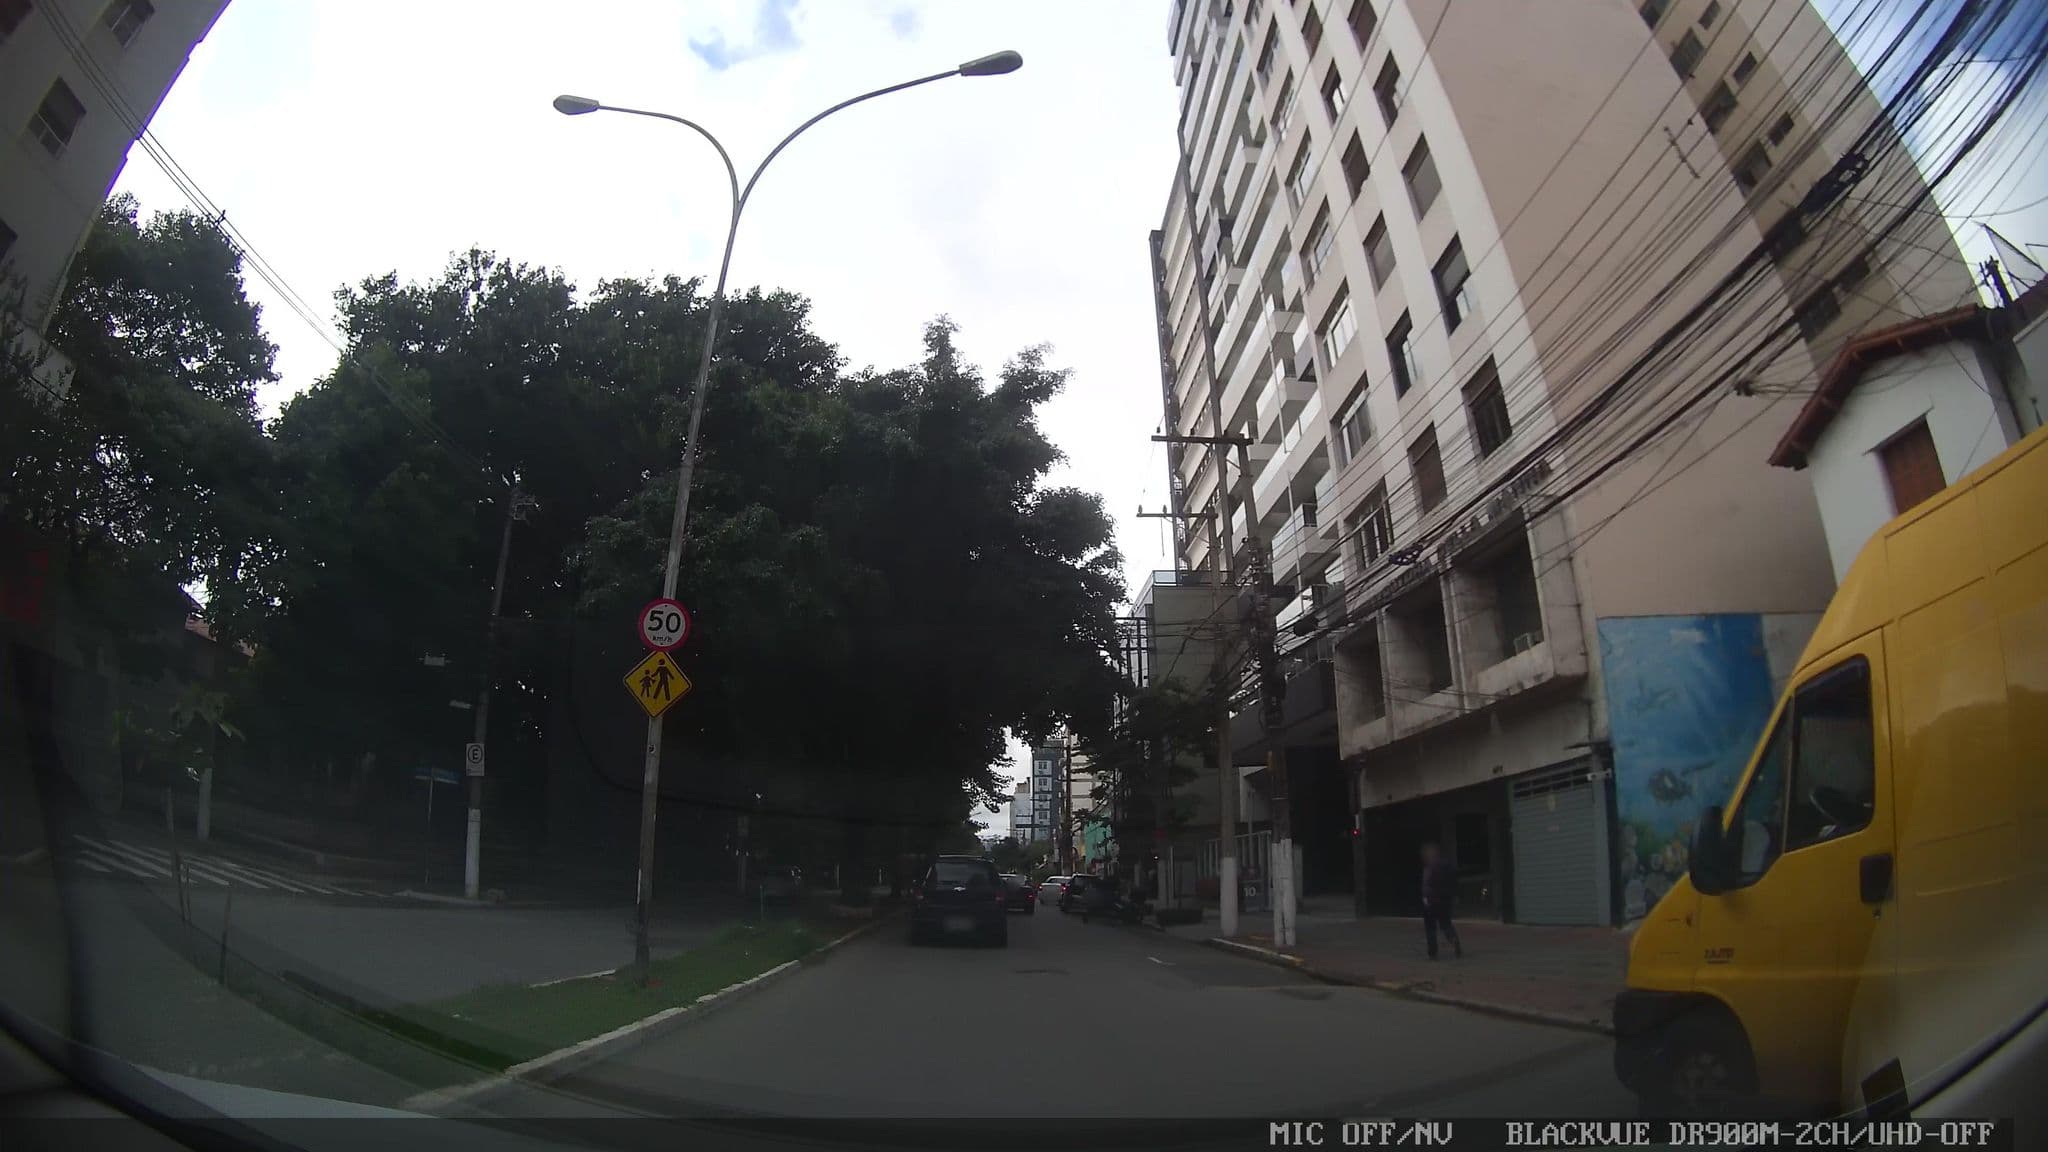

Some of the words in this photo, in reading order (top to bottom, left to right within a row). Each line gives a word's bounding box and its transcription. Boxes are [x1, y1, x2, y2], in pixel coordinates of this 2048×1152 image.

[648, 609, 681, 633] 50
[652, 635, 673, 643] km/h
[472, 748, 480, 760] E
